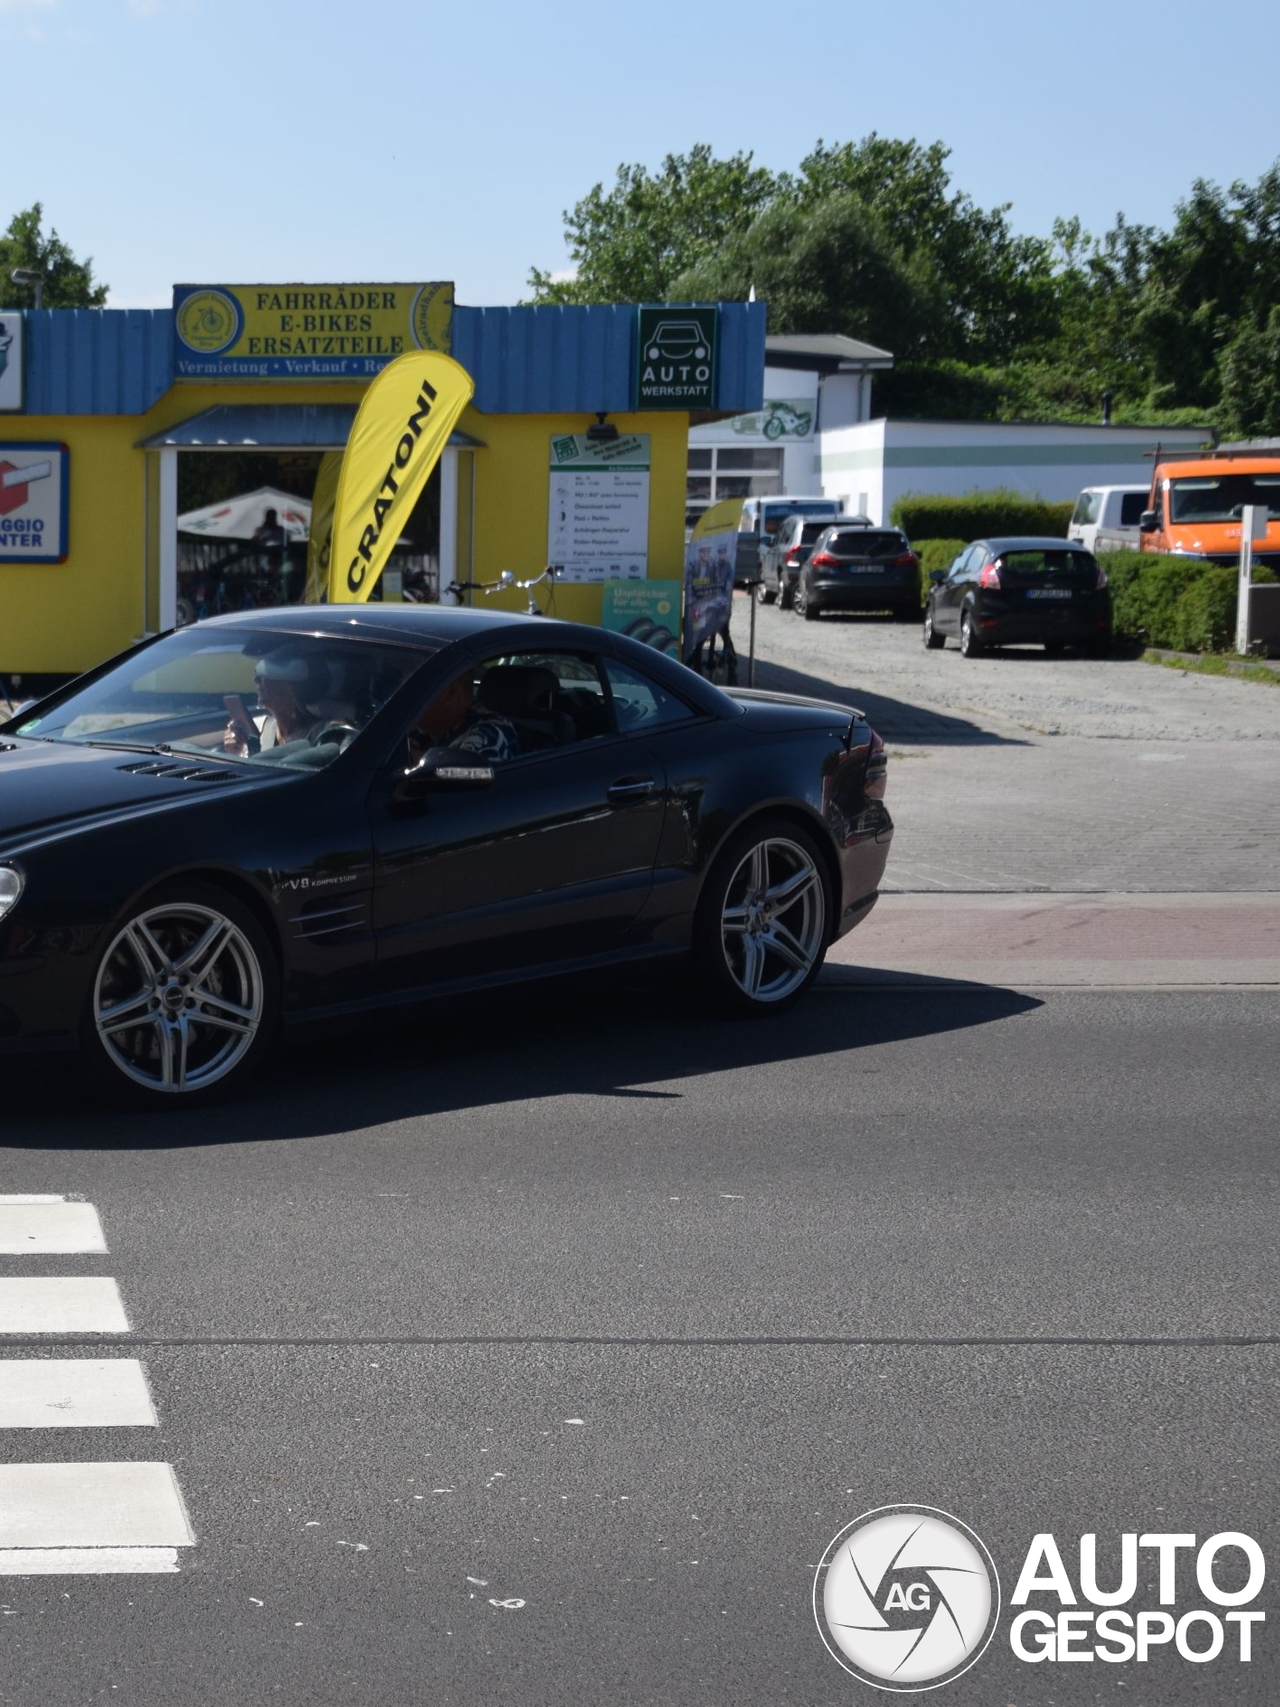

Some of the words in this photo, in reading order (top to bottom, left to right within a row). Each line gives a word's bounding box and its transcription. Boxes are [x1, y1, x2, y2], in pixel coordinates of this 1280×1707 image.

[256, 288, 397, 310] FAHRRÄDER
[280, 315, 373, 333] E-BIKES
[248, 336, 404, 355] ERSATZTEILE
[179, 361, 269, 376] Vermietung
[286, 360, 348, 374] Verkauf
[642, 366, 710, 382] AUTO
[642, 386, 709, 396] WERKSTATT
[347, 379, 438, 594] CRATONI
[290, 877, 309, 890] V8
[312, 875, 357, 887] KOMPRESSOR
